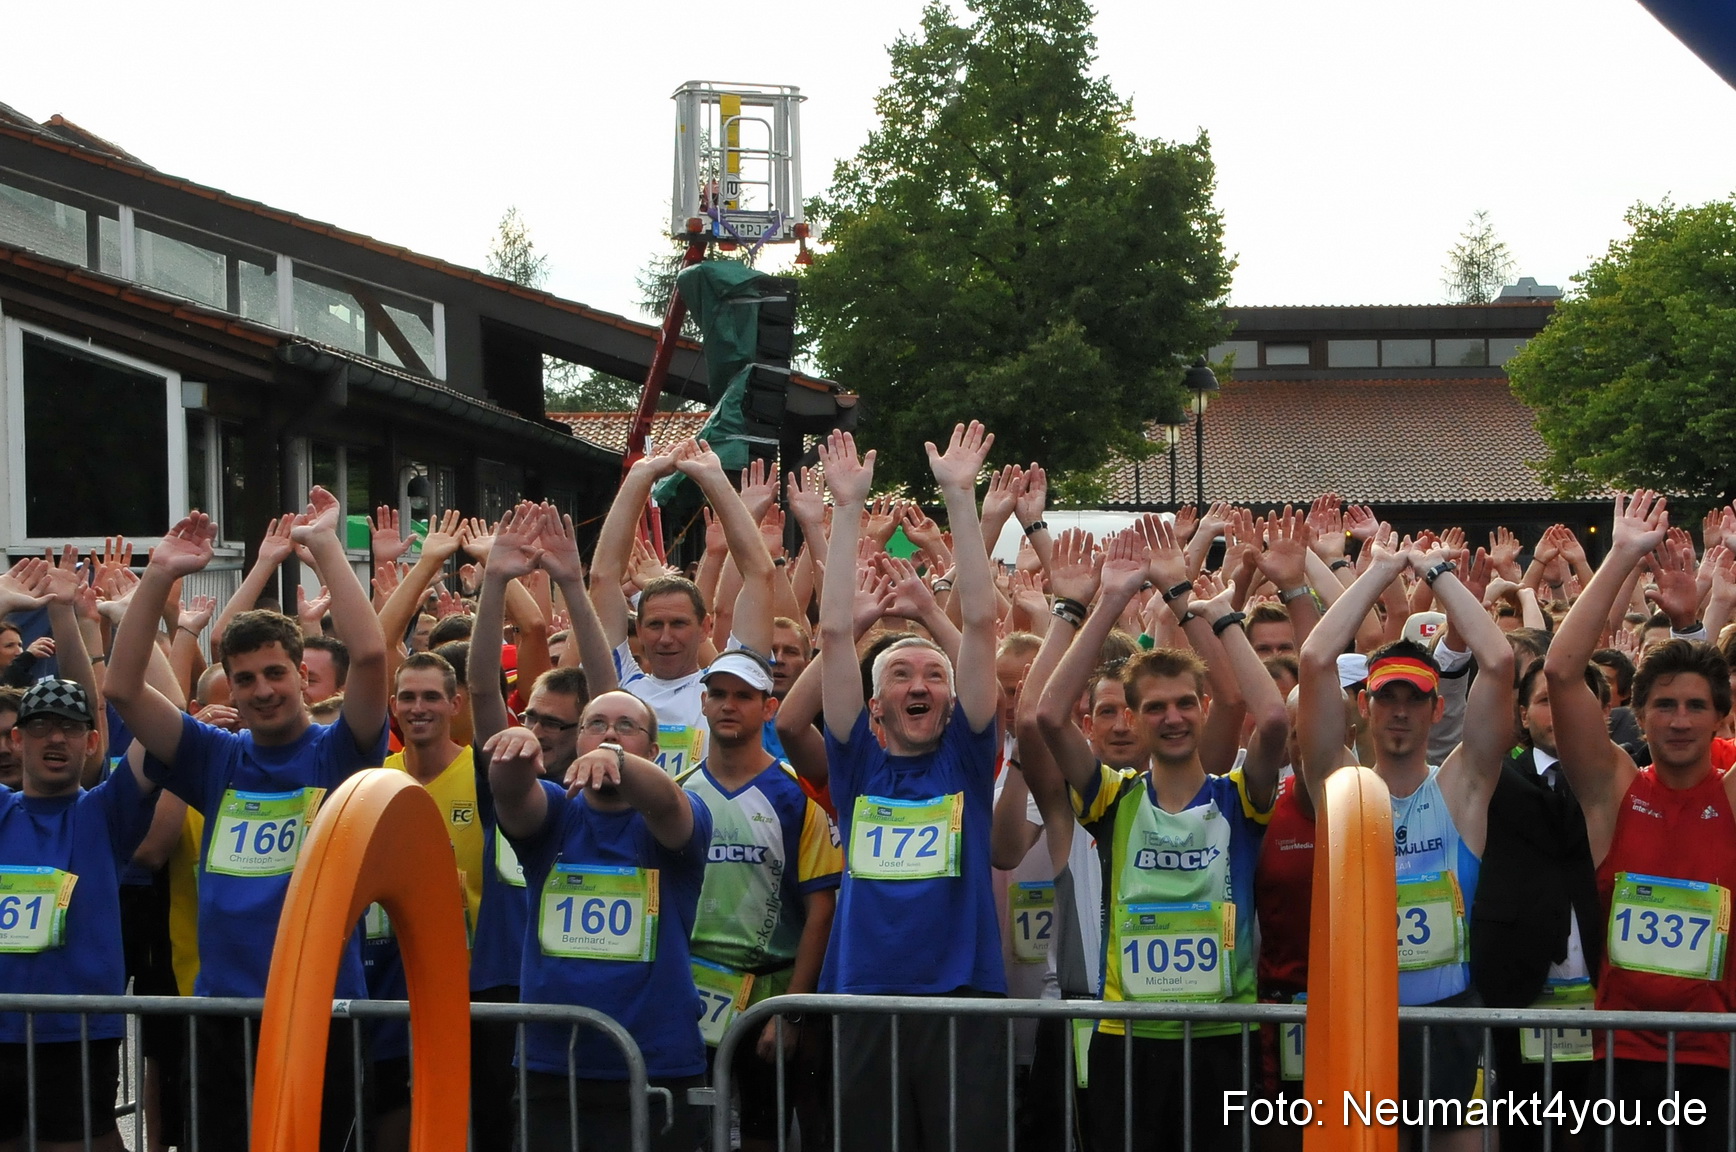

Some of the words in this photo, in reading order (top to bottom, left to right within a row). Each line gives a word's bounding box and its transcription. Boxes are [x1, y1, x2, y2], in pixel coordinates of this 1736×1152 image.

[453, 809, 471, 823] FC
[230, 818, 297, 855] 166
[866, 825, 939, 858] 172
[1142, 830, 1194, 848] TEAM
[229, 854, 273, 865] Christoph
[1134, 845, 1220, 871] BOCK
[0, 896, 42, 930] 61
[556, 897, 632, 936] 160
[1016, 911, 1053, 940] 12
[562, 934, 606, 945] Bernhard
[1616, 908, 1711, 951] 1337
[1123, 937, 1218, 974] 1059
[1145, 976, 1182, 985] Michael
